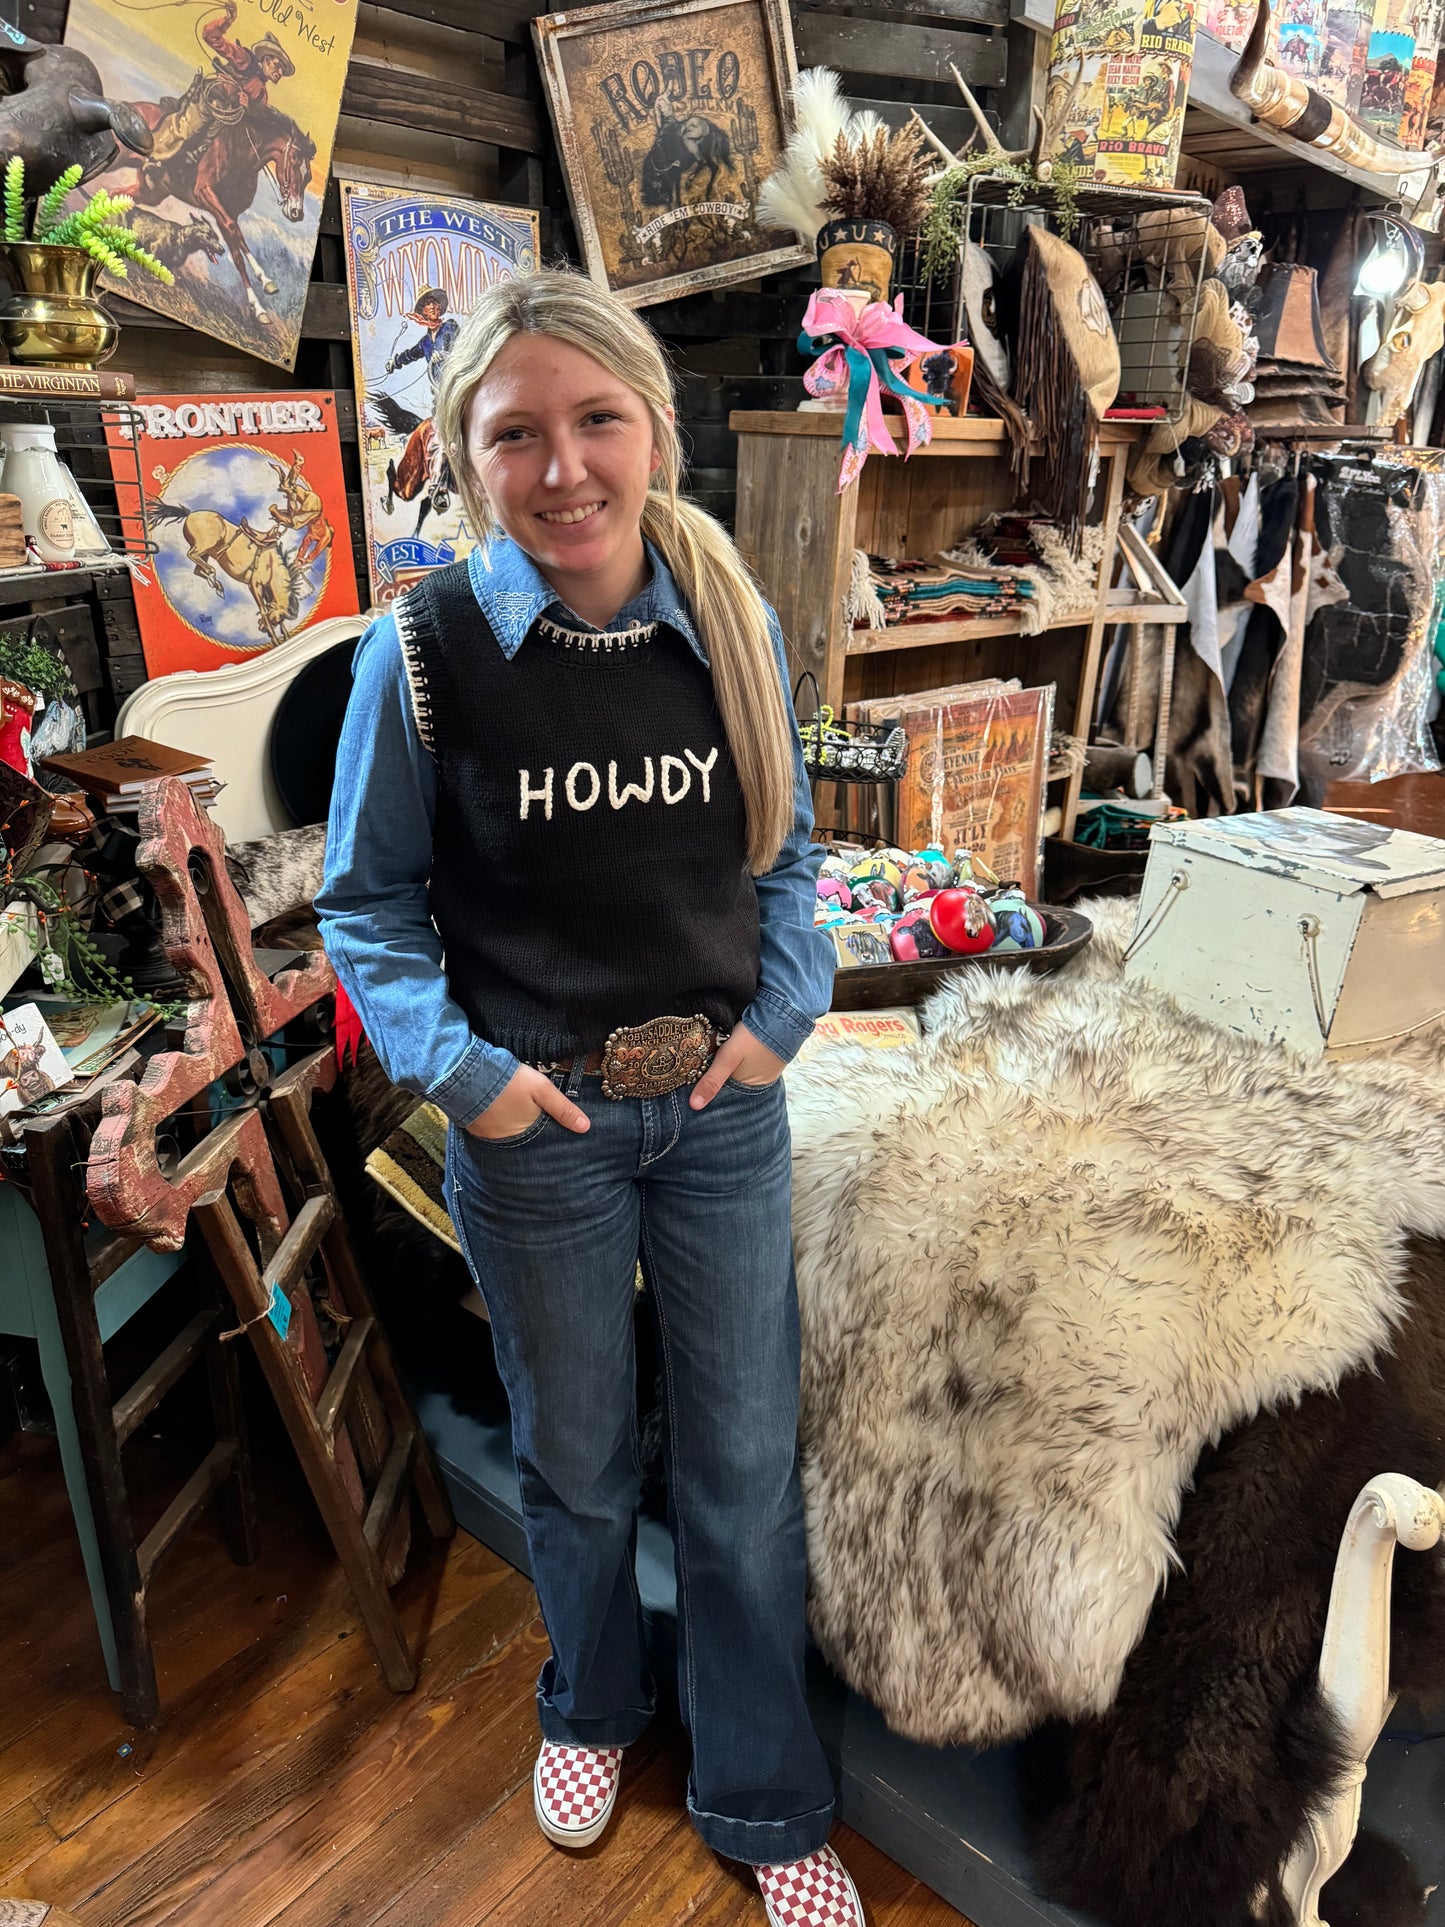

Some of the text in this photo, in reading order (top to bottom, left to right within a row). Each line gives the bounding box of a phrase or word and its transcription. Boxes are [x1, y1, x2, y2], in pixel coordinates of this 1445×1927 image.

[295, 10, 336, 56] West
[1141, 34, 1162, 49] RIO
[597, 49, 740, 133] RODEO
[1128, 141, 1166, 155] BRAVO
[380, 209, 513, 251] THE WEST
[646, 218, 668, 236] RIDE
[377, 236, 514, 318] WYOMIN
[25, 374, 101, 392] VIRGINIAN
[120, 400, 327, 440] FRONTIER
[391, 543, 420, 562] EST.
[519, 746, 719, 821] HOWDY
[648, 1023, 680, 1039] SADDLE
[681, 1021, 700, 1033] CLUB
[815, 1017, 905, 1038] oy Rogers
[631, 1032, 689, 1048] RANCH RODEO
